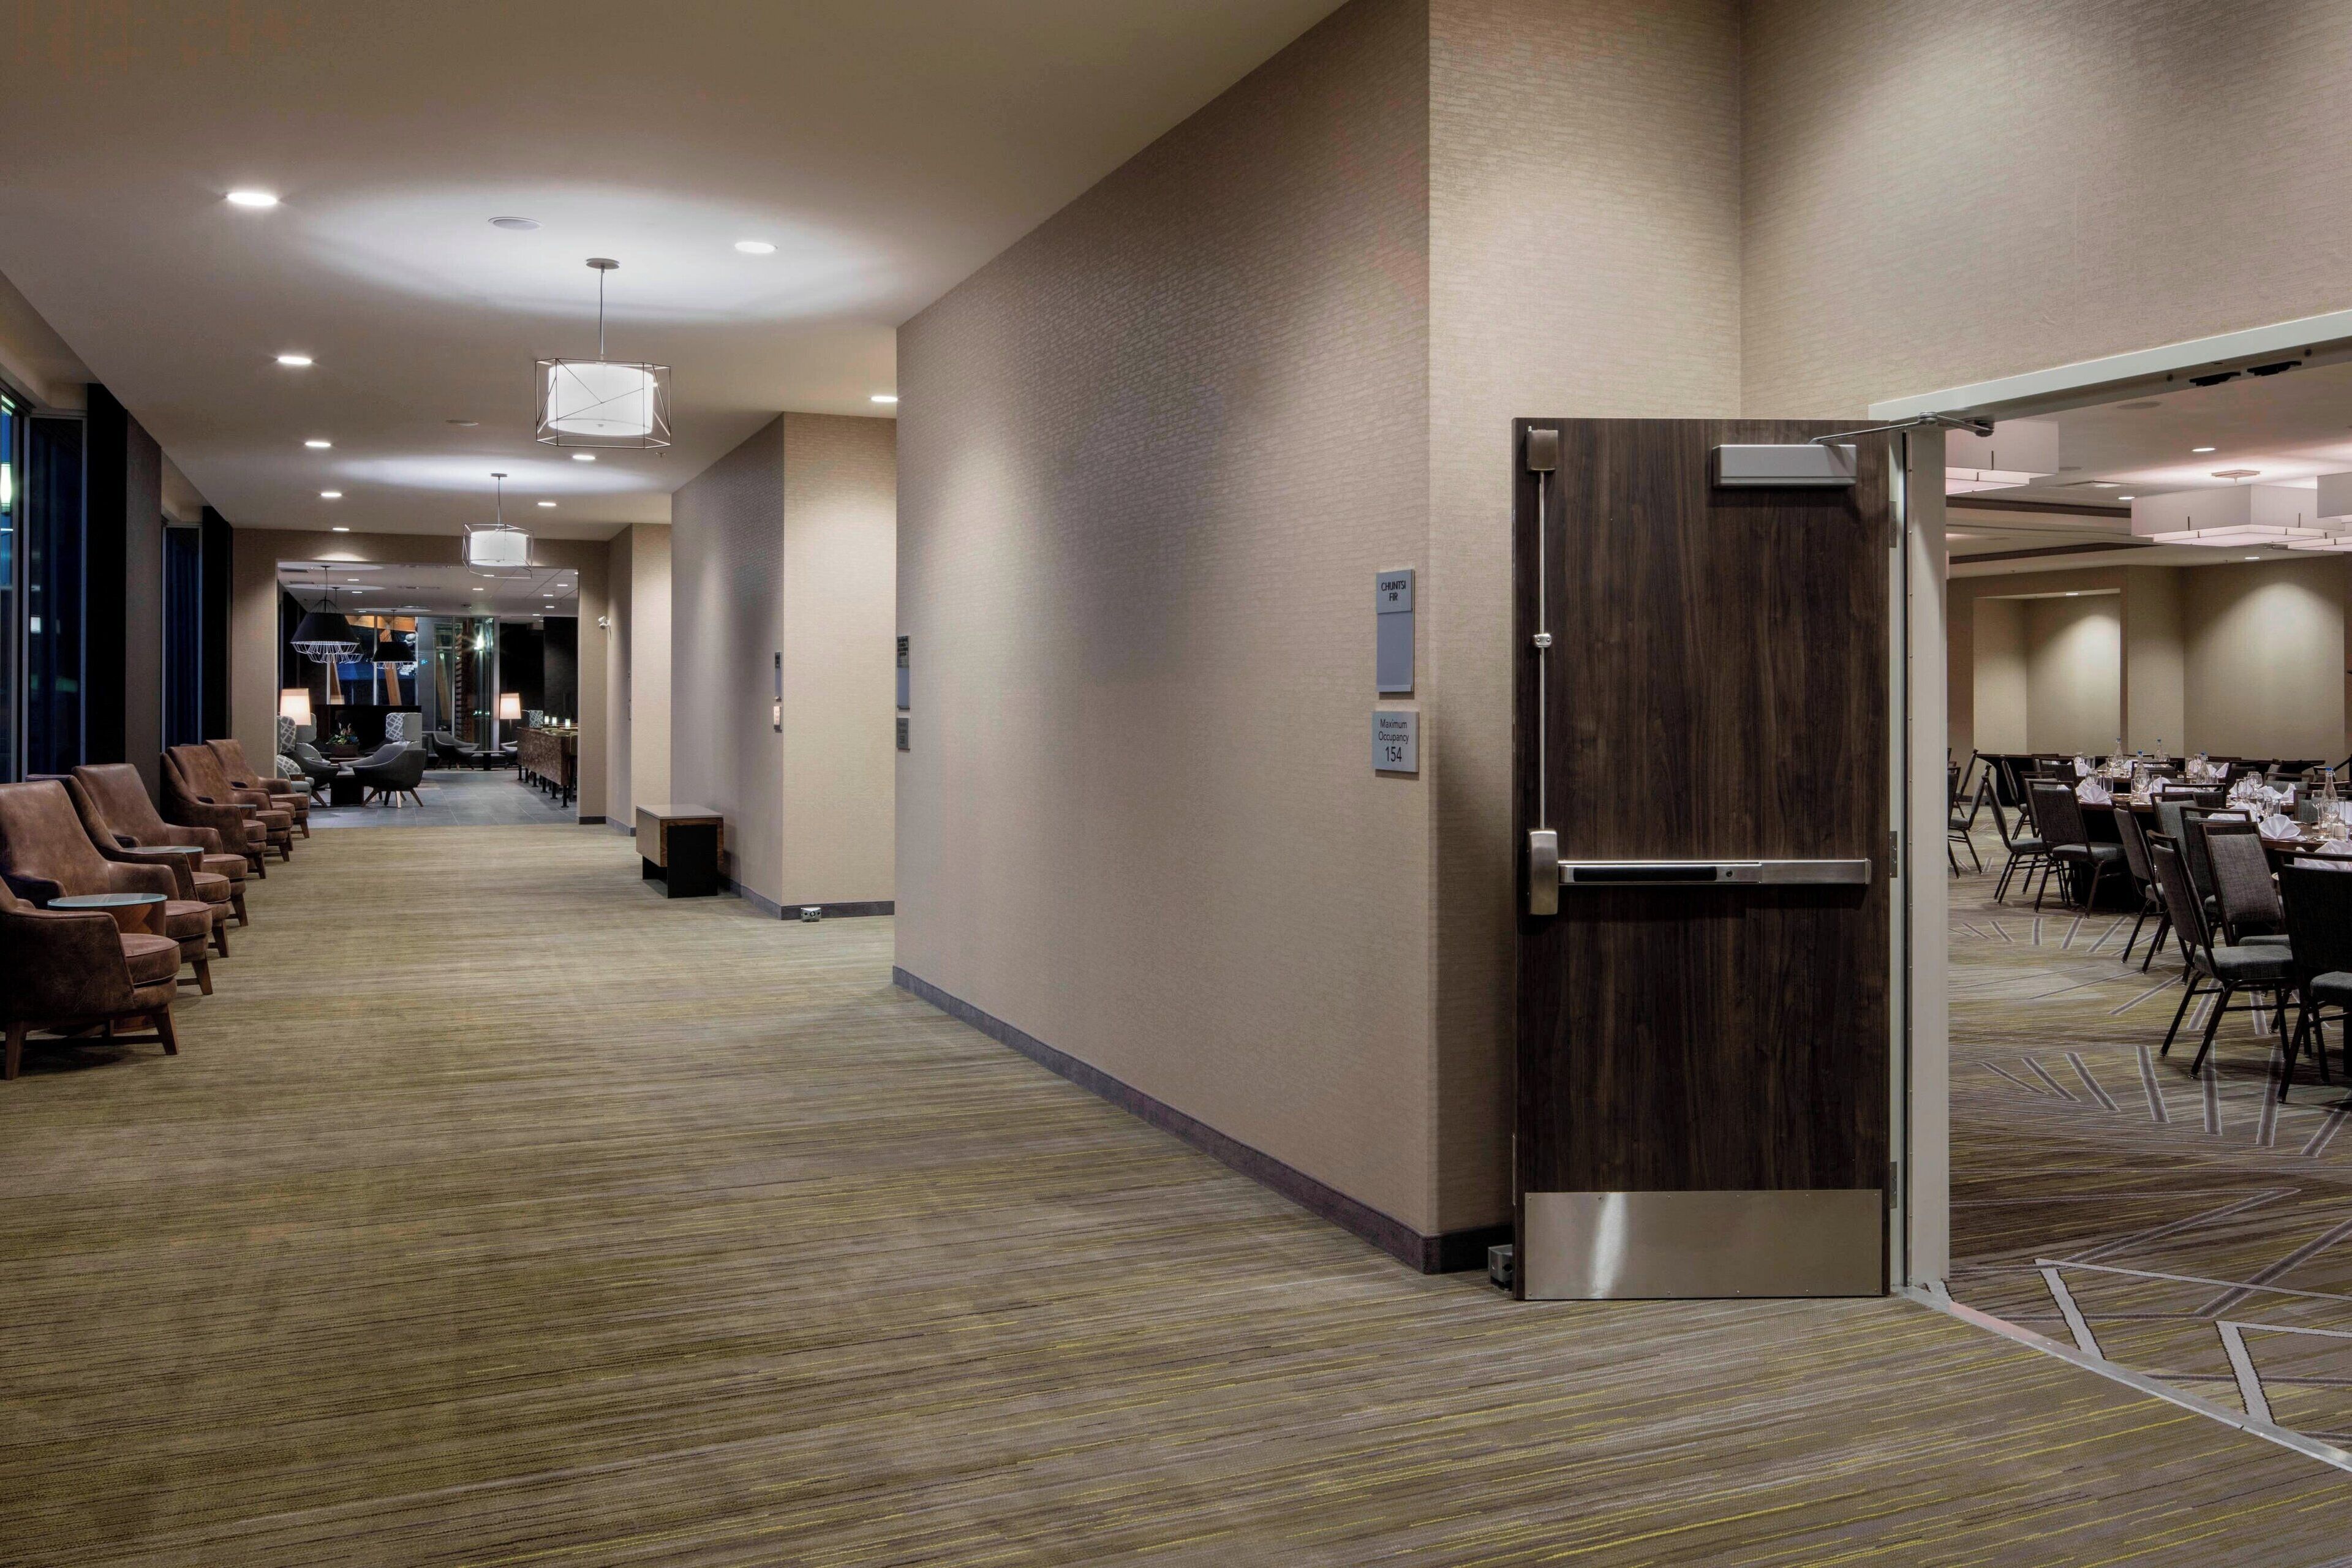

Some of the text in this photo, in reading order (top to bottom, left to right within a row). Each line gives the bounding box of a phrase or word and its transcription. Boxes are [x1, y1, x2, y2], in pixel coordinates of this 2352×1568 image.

[1389, 592, 1398, 601] FIR
[1380, 718, 1408, 729] Maximum
[1378, 731, 1409, 745] Occupancy
[1385, 746, 1402, 763] 154
